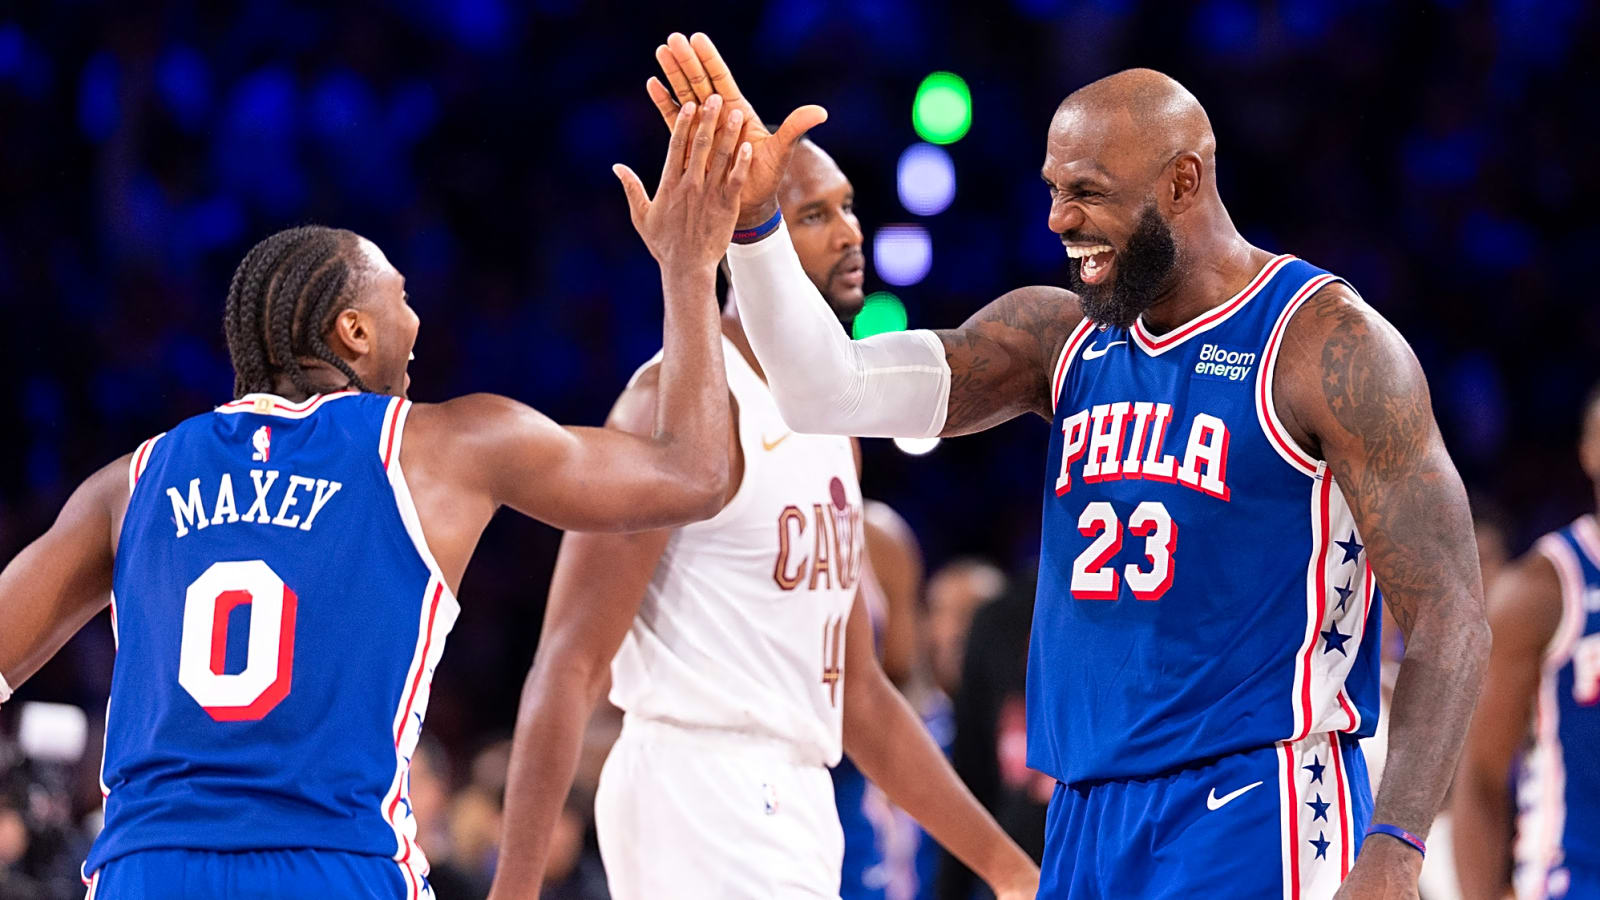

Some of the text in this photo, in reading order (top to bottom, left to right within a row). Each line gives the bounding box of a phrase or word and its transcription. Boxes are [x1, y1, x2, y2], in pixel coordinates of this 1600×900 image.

[1195, 361, 1251, 381] energy
[1199, 343, 1256, 366] Bloom
[1055, 401, 1231, 502] PHILA
[166, 469, 342, 538] MAXEY
[1070, 501, 1179, 601] 23
[178, 559, 299, 722] 0
[822, 614, 841, 708] 4
